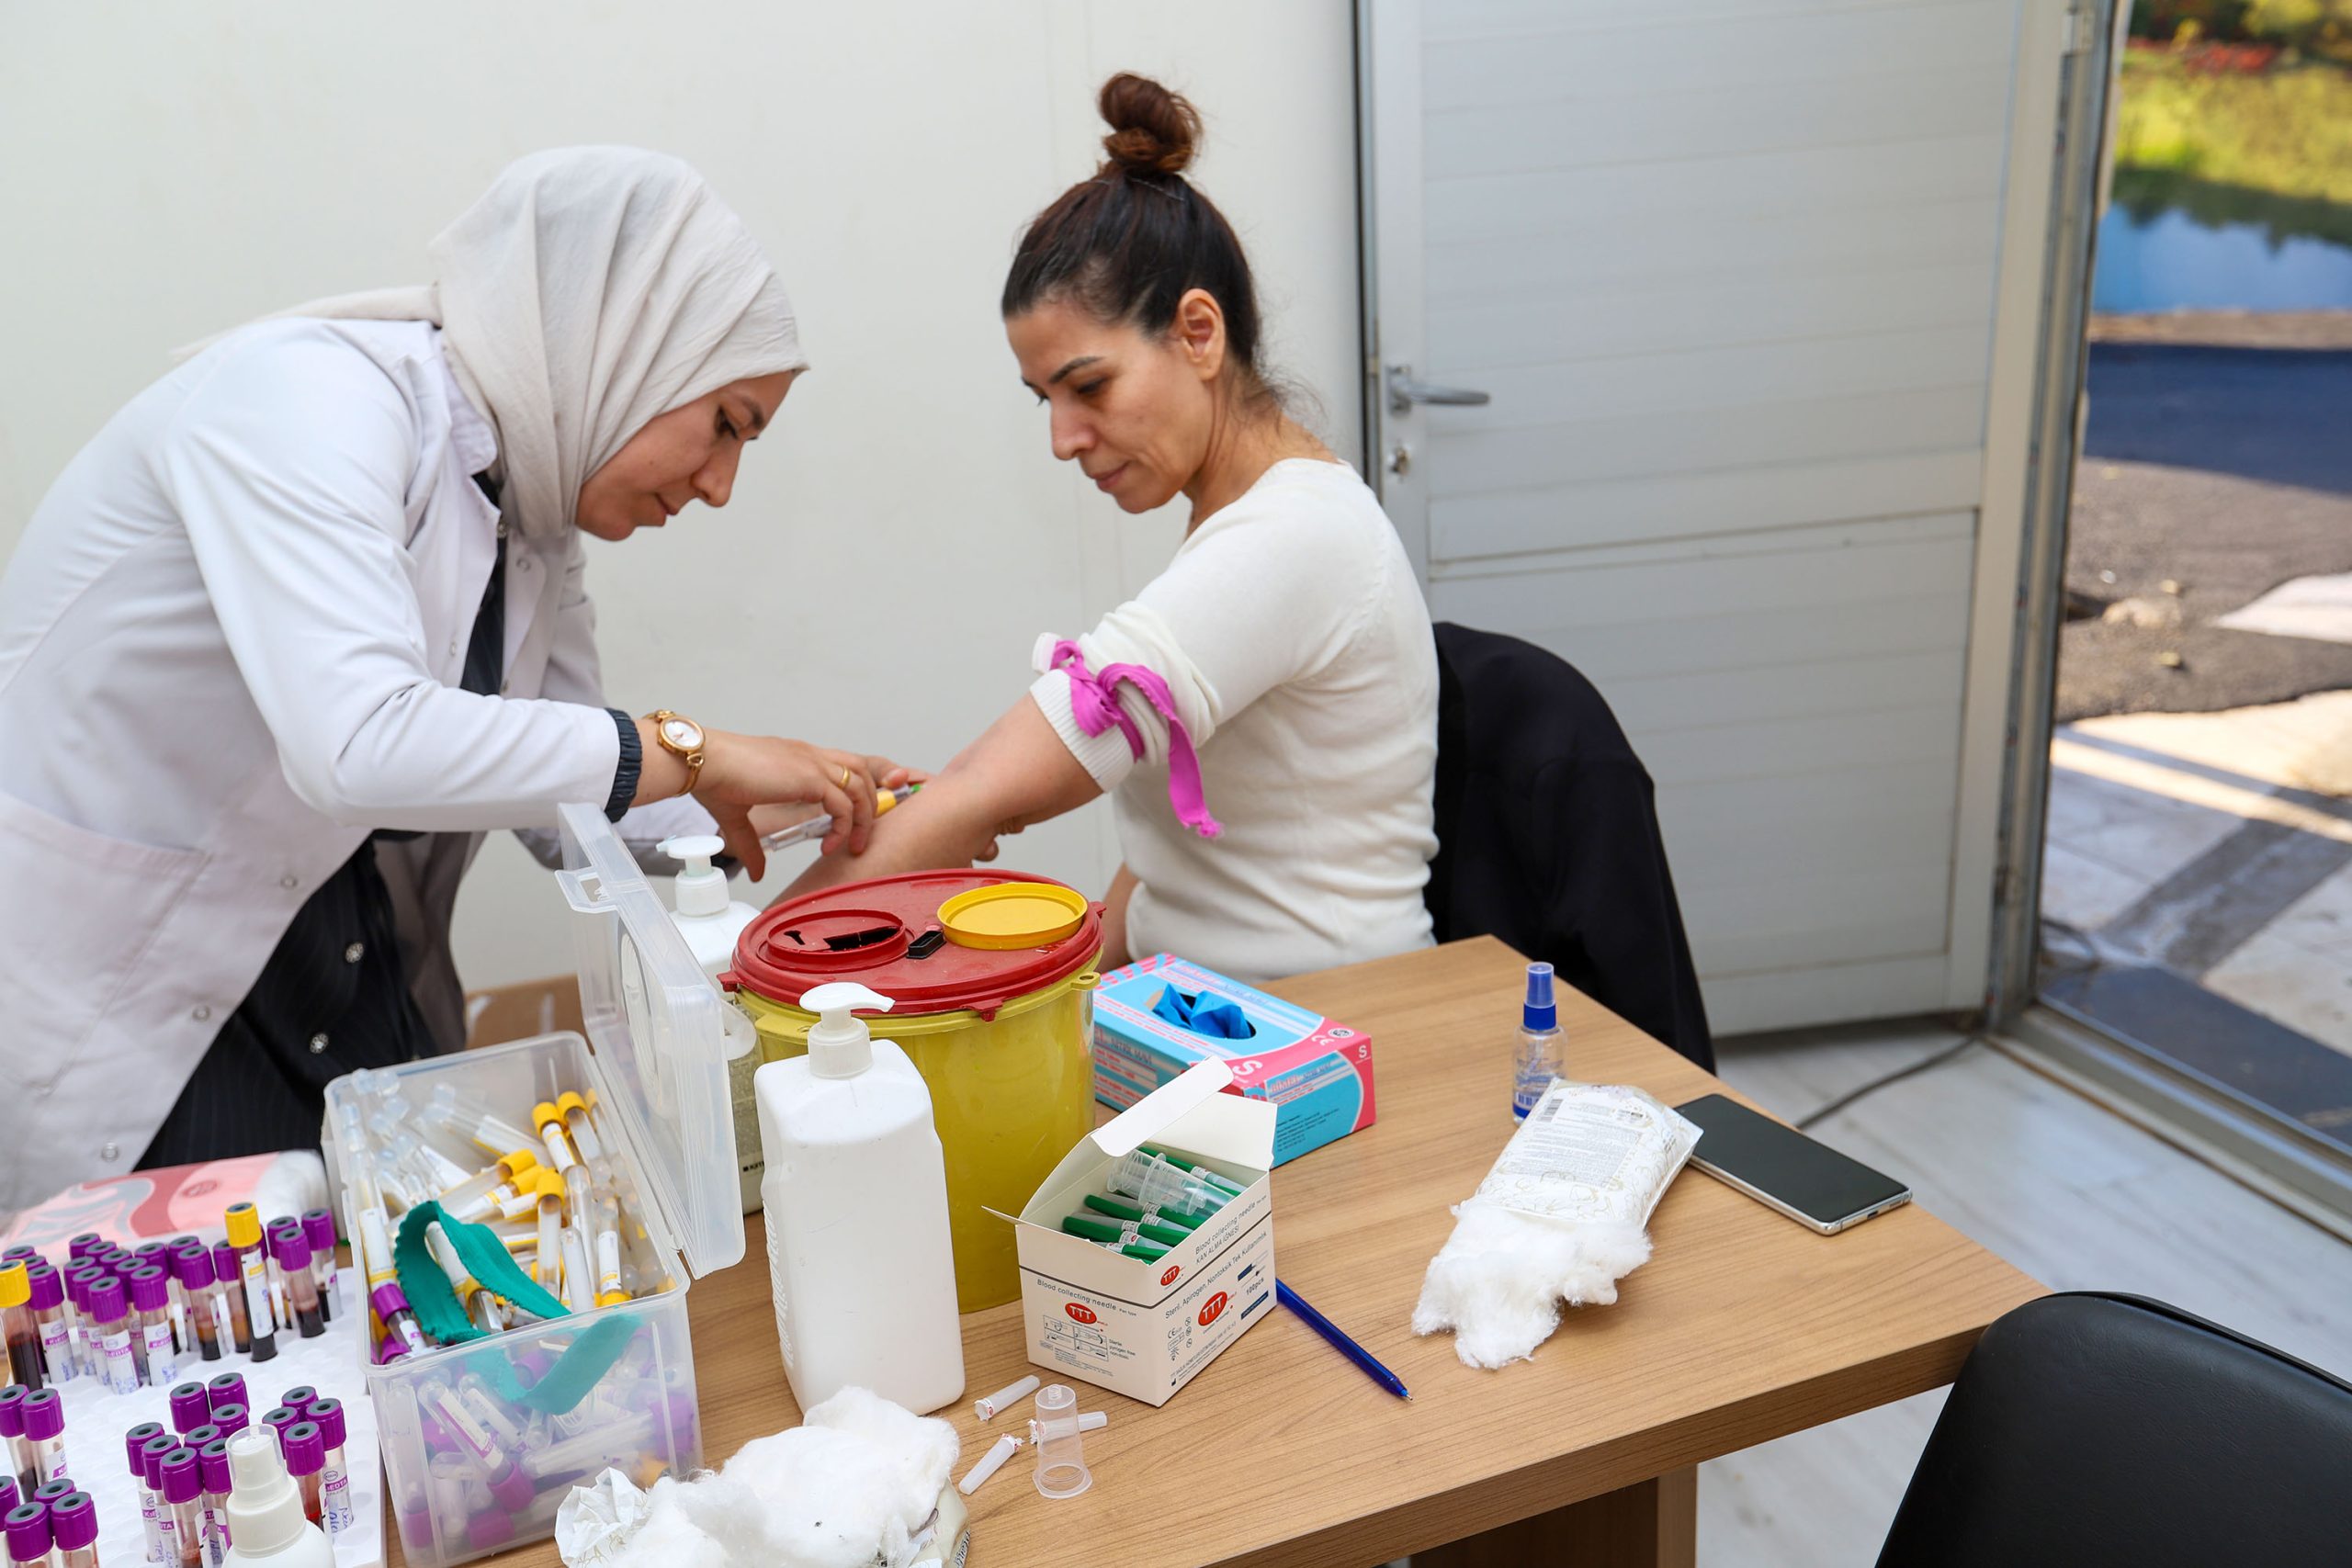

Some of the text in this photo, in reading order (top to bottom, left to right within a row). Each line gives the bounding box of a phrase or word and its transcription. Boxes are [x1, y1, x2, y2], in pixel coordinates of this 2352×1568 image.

[1359, 1045, 1368, 1058] S
[1232, 1061, 1263, 1076] S
[1195, 1201, 1256, 1255] Blood collecting needle
[1196, 1252, 1208, 1264] KAN
[1208, 1240, 1223, 1256] ALMA
[1163, 1268, 1177, 1282] TTT
[1207, 1261, 1232, 1286] Nontoksik
[1037, 1279, 1056, 1292] Blood
[1057, 1287, 1091, 1303] collecting
[1091, 1298, 1116, 1311] needle
[1069, 1305, 1091, 1320] TTT
[1202, 1296, 1223, 1321] TTT
